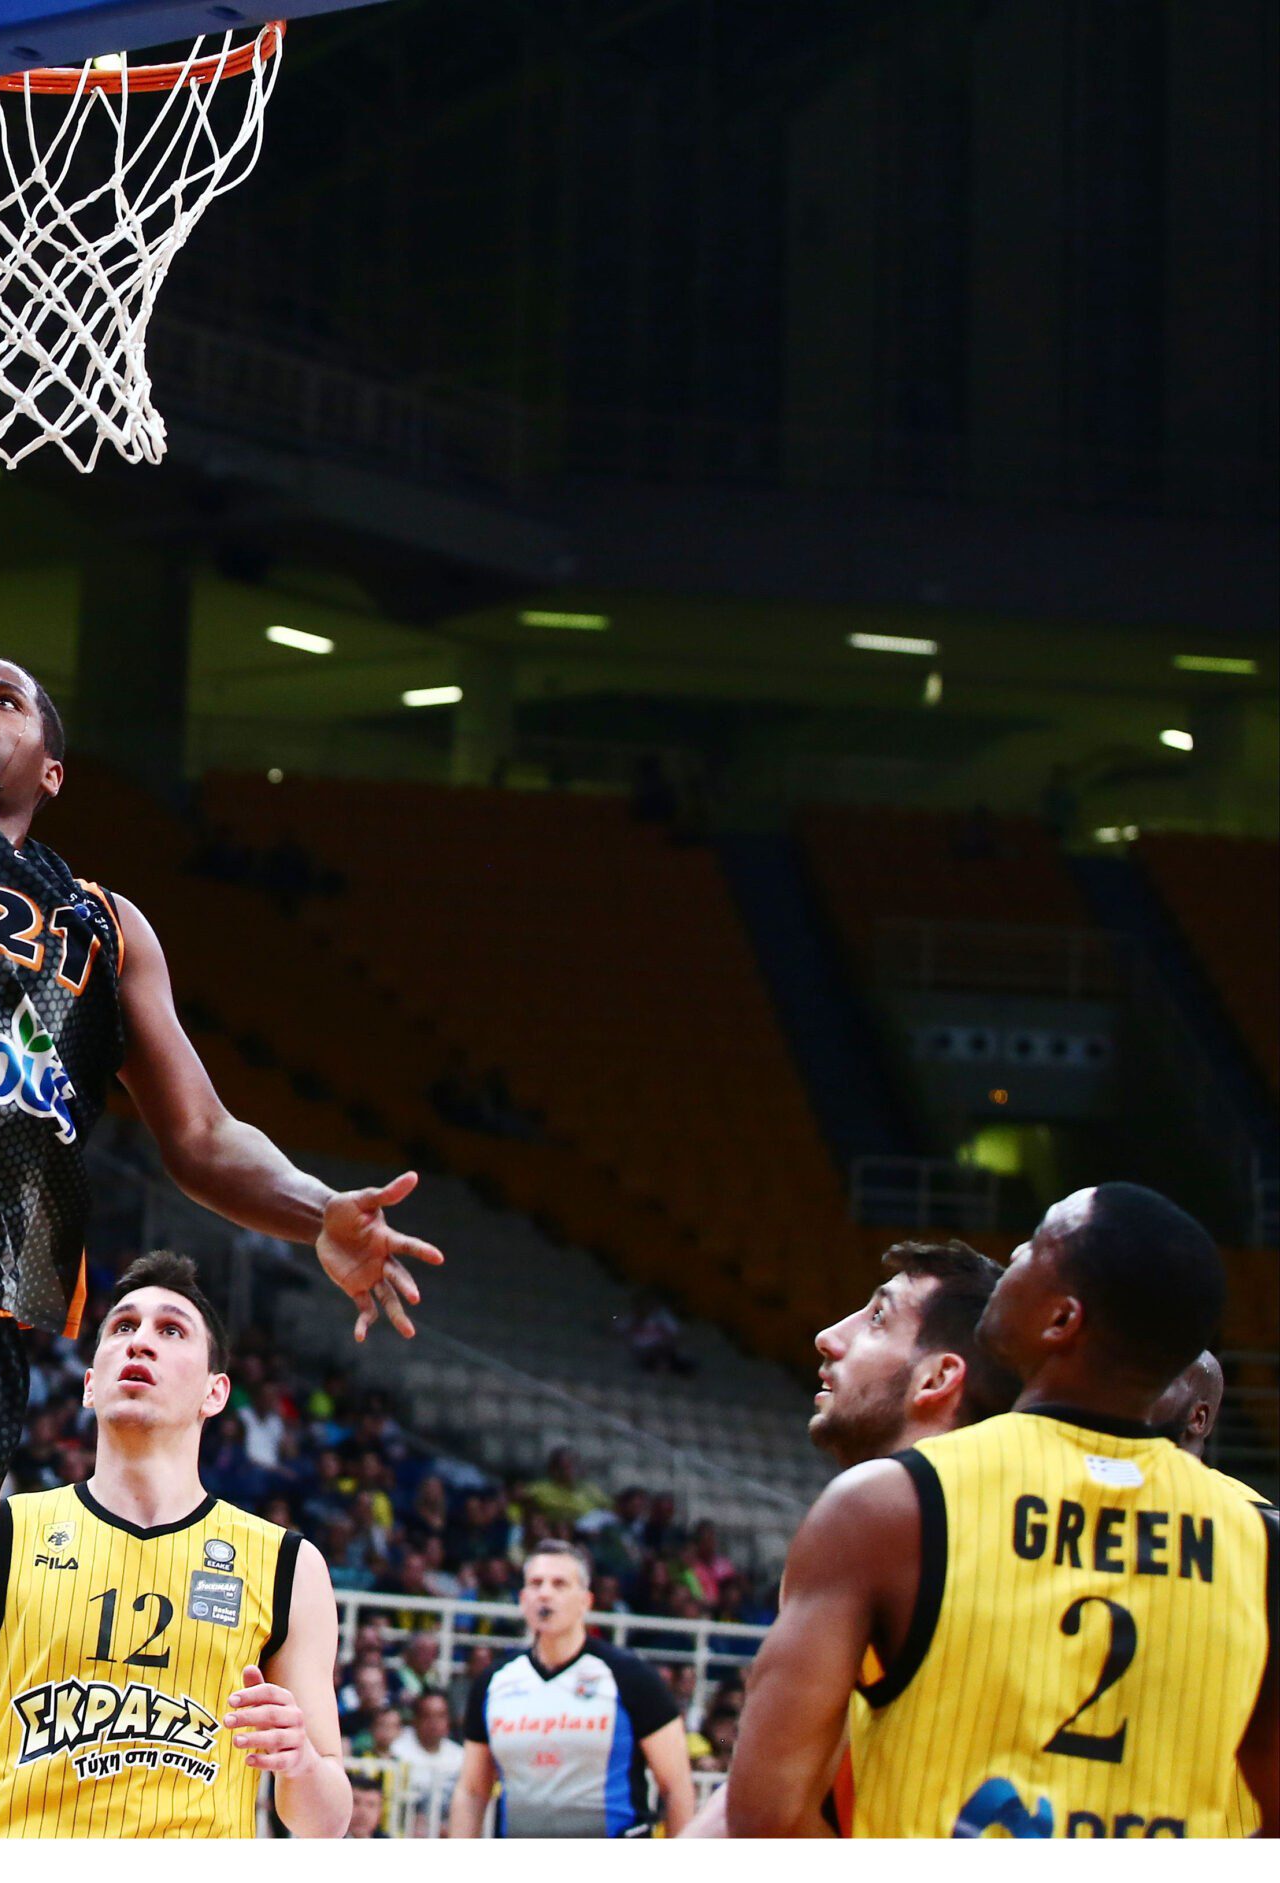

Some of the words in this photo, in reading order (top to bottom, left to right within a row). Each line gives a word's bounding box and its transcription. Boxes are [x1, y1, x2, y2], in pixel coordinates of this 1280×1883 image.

[34, 1554, 79, 1570] FILA
[1012, 1494, 1215, 1584] GREEN
[86, 1587, 174, 1668] 12
[1043, 1596, 1138, 1763] 2
[74, 1752, 120, 1778] Τύχη
[125, 1750, 158, 1767] στη
[162, 1752, 216, 1782] στιγμή
